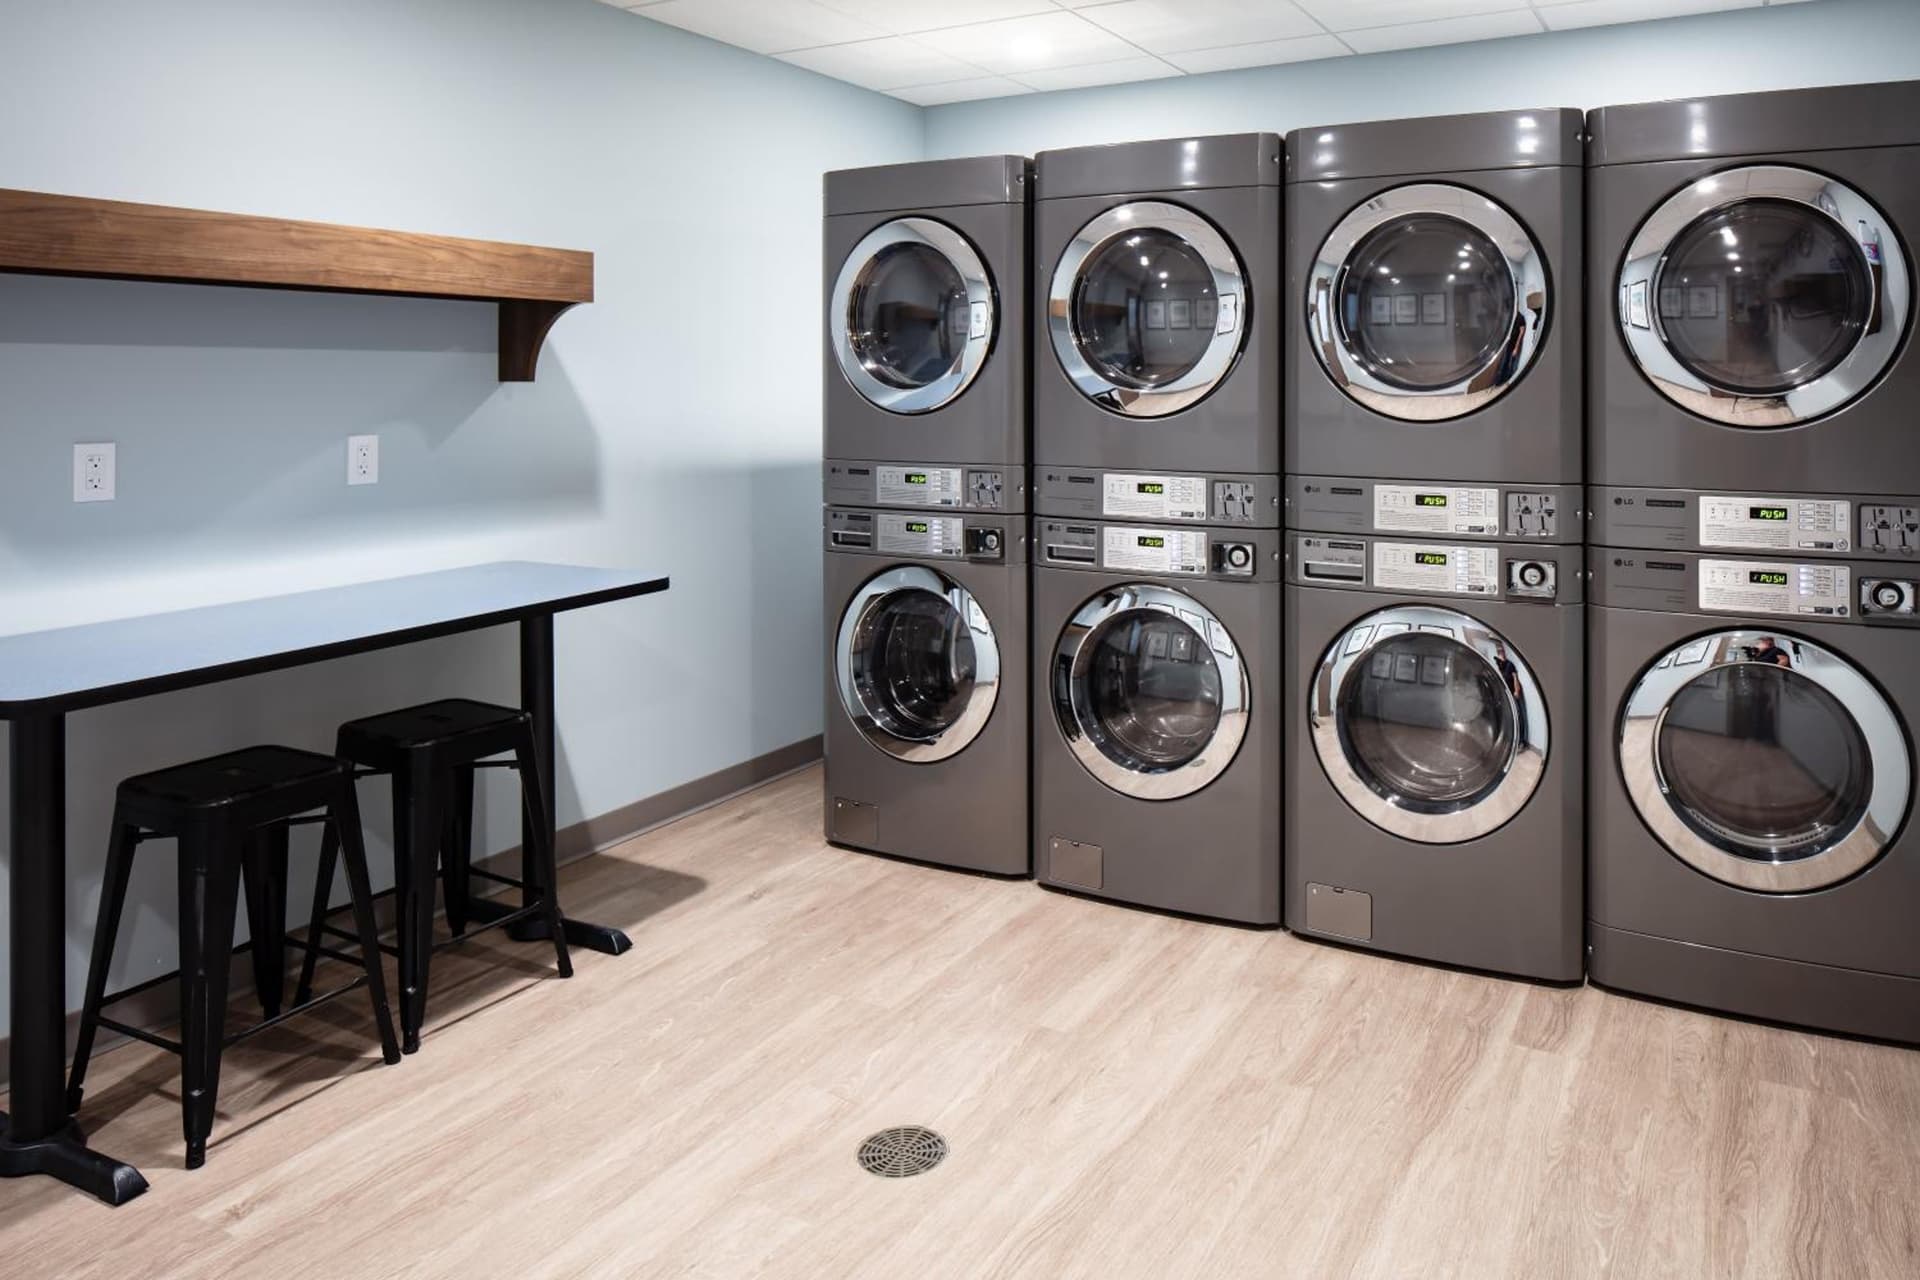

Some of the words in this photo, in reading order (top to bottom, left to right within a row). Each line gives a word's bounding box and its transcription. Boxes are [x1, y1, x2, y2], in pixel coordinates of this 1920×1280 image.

[1424, 496, 1446, 505] PUSH
[1759, 509, 1786, 519] PUSH
[1424, 554, 1446, 564] PUSH
[1759, 573, 1786, 584] PUSH
